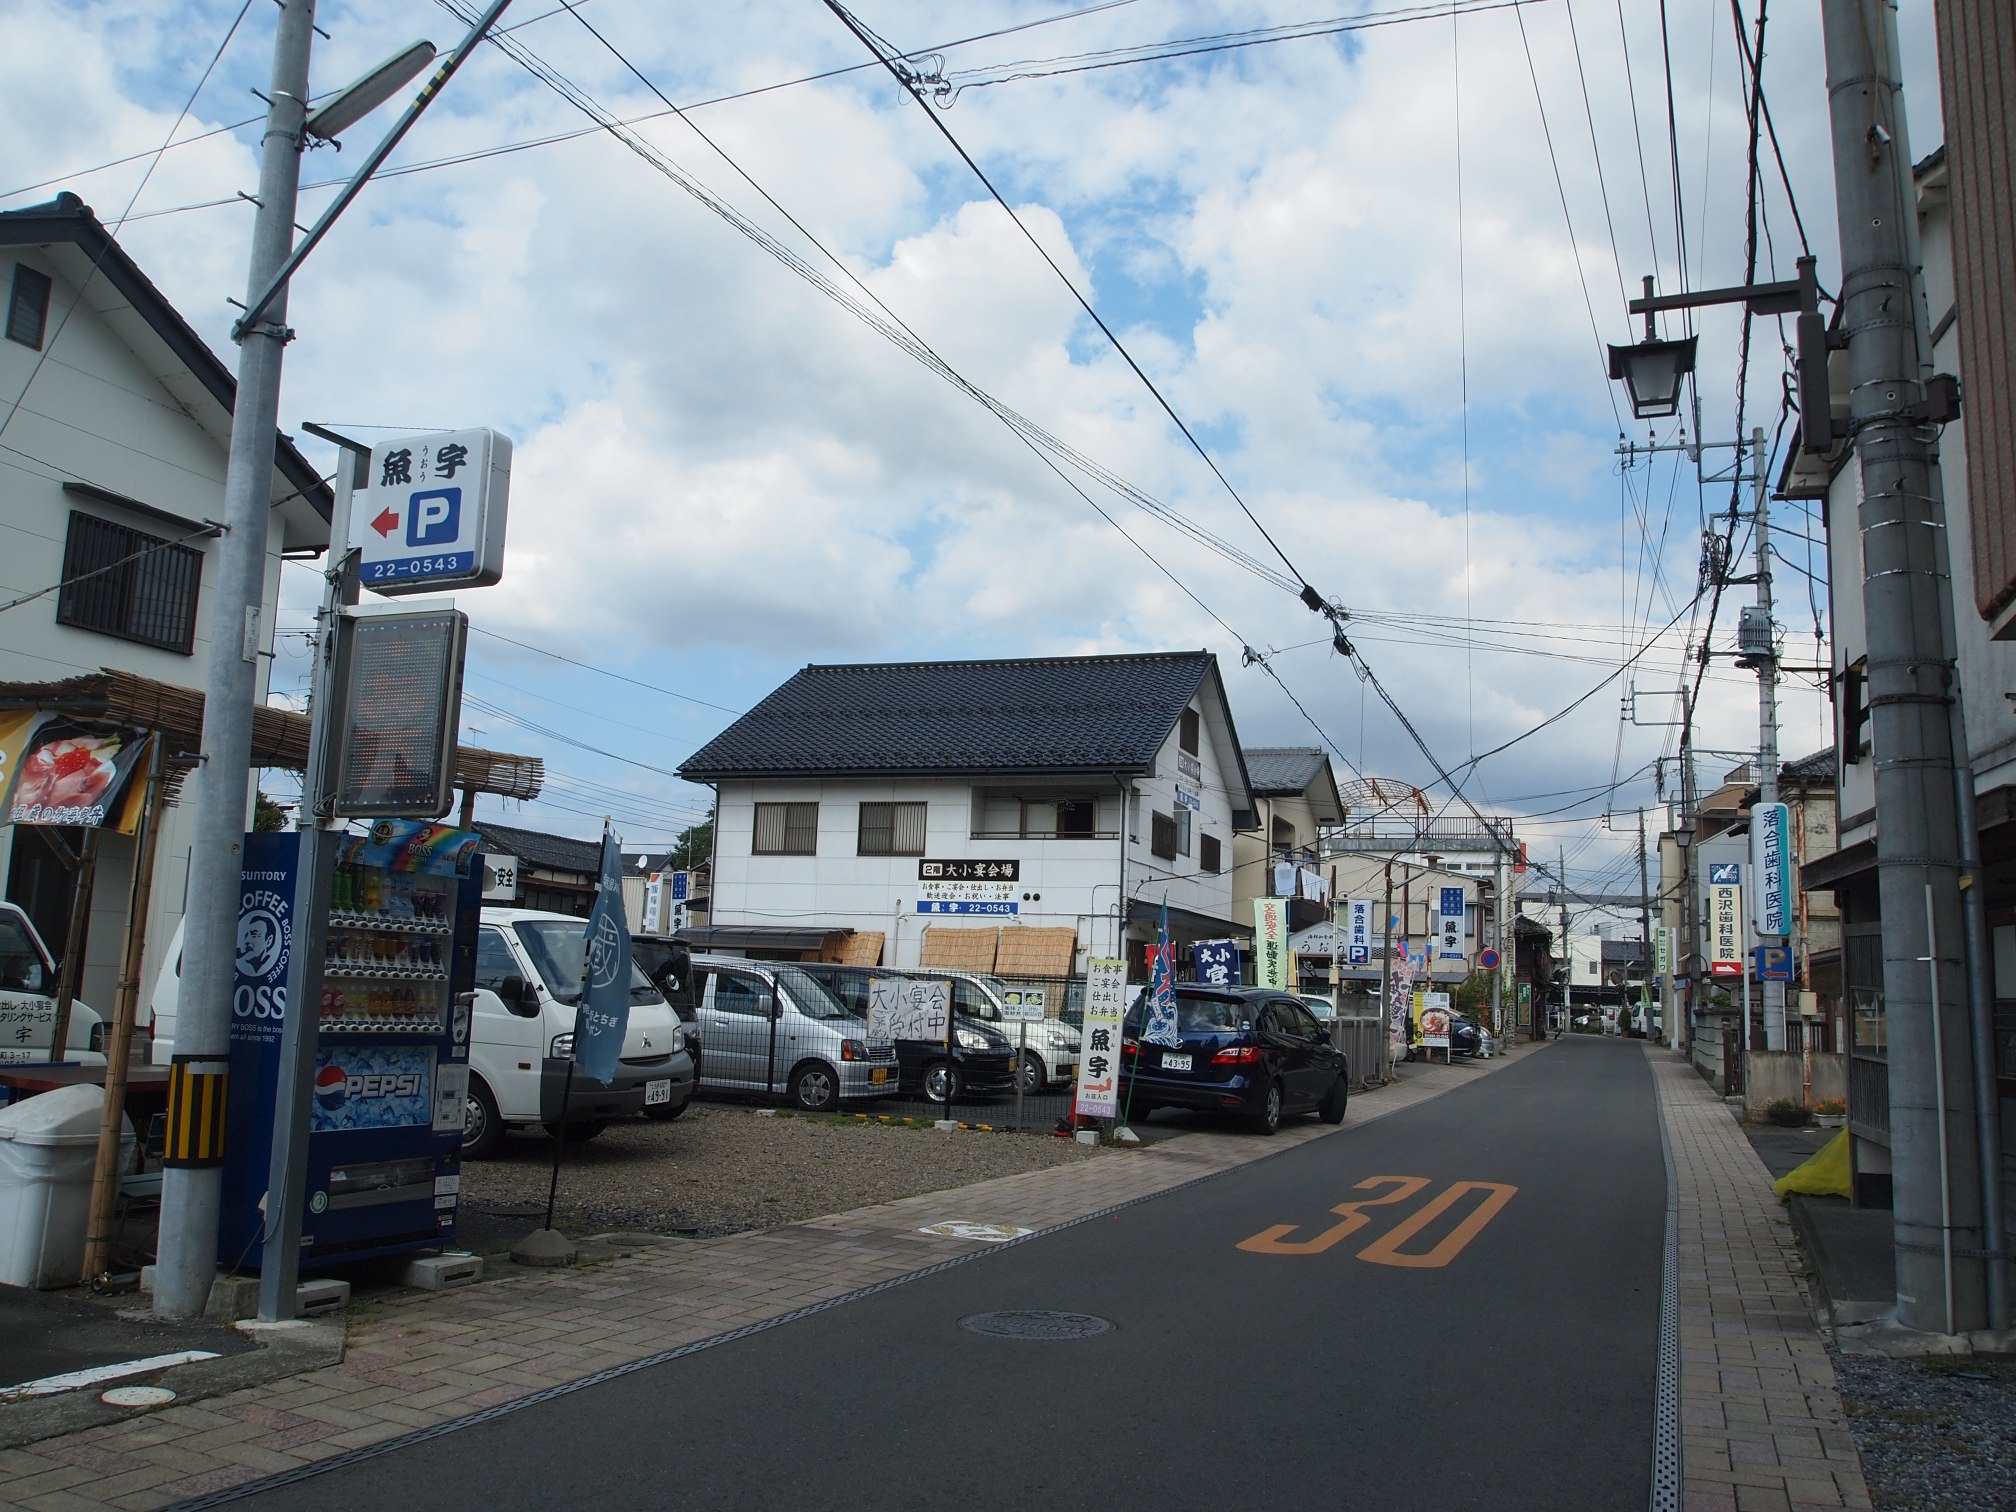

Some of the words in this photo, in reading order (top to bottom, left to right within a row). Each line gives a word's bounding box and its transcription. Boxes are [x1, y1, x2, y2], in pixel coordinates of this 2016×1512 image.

[419, 445, 429, 483] うおう
[416, 497, 450, 539] P
[374, 556, 457, 578] 22-0543
[408, 843, 433, 857] BOSS
[241, 871, 288, 881] SUNTORY
[493, 866, 514, 888] 安全
[925, 865, 941, 875] 2階
[945, 862, 1014, 878] 大小宴会場
[1763, 809, 1784, 931] 落合歯科医院
[969, 904, 1011, 913] 22-0543
[1354, 904, 1365, 945] 落合歯科
[1718, 887, 1735, 959] 西沢歯科医院
[1351, 947, 1364, 960] P
[1765, 949, 1785, 969] P
[1093, 963, 1122, 976] お食事
[1092, 977, 1121, 989] ご宴会
[233, 985, 287, 1020] OSS
[871, 983, 946, 1011] 大小宴会
[1092, 991, 1119, 1002] 仕出し
[0, 1000, 52, 1011] 出し・大小宴会
[1090, 1006, 1118, 1018] お弁当
[240, 1023, 257, 1031] BOSS
[889, 1010, 946, 1039] 受付中
[262, 1035, 275, 1043] 1992
[344, 1074, 421, 1098] PEPSI
[1085, 1092, 1109, 1101] お店入口
[1080, 1103, 1111, 1115] 22-0543
[1235, 1175, 1519, 1268] 30
